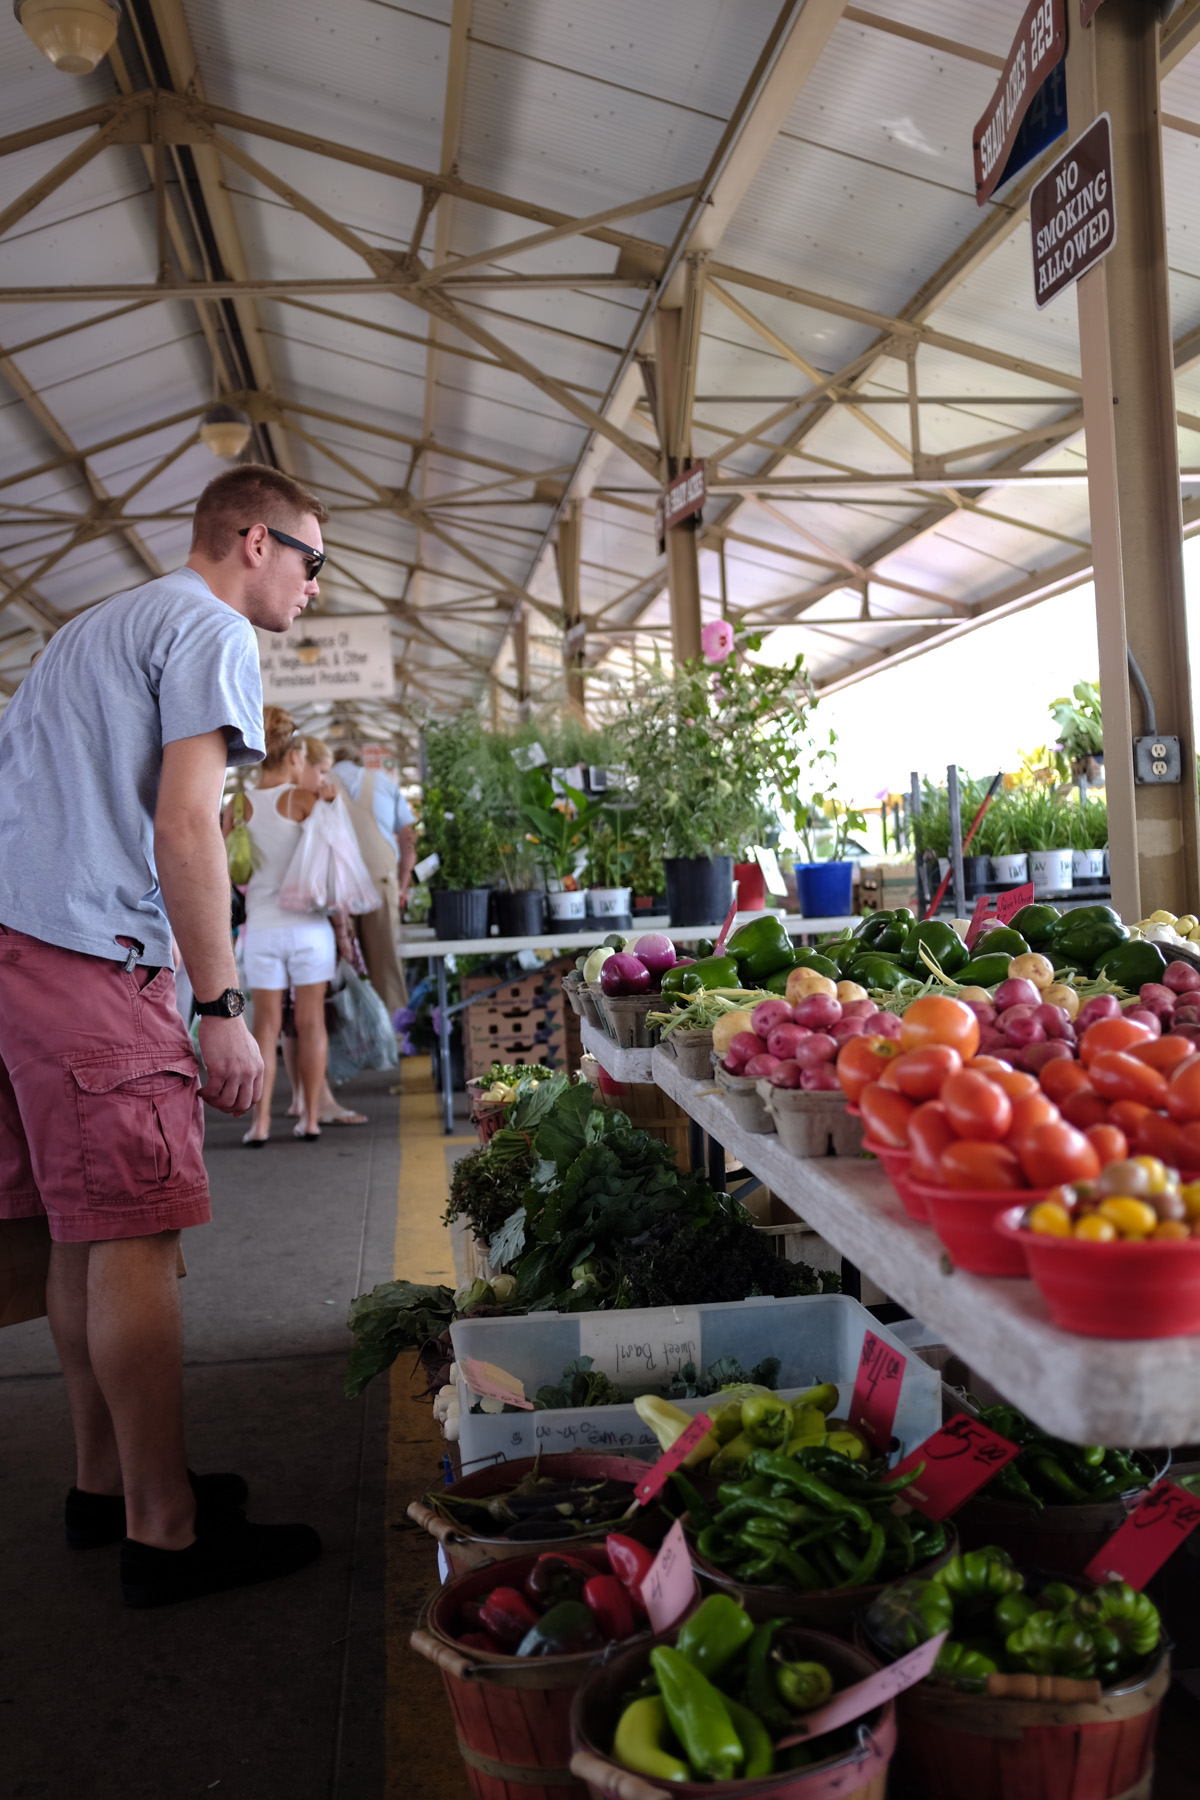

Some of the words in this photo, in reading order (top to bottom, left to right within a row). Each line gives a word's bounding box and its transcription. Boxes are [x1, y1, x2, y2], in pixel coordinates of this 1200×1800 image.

[980, 94, 1006, 181] SHADY
[1006, 40, 1027, 133] ACRES
[1030, 0, 1053, 73] 229
[1036, 169, 1107, 260] SMOKING
[1056, 160, 1079, 204] NO
[1038, 208, 1110, 295] ALLOWED
[615, 1342, 657, 1374] Basil
